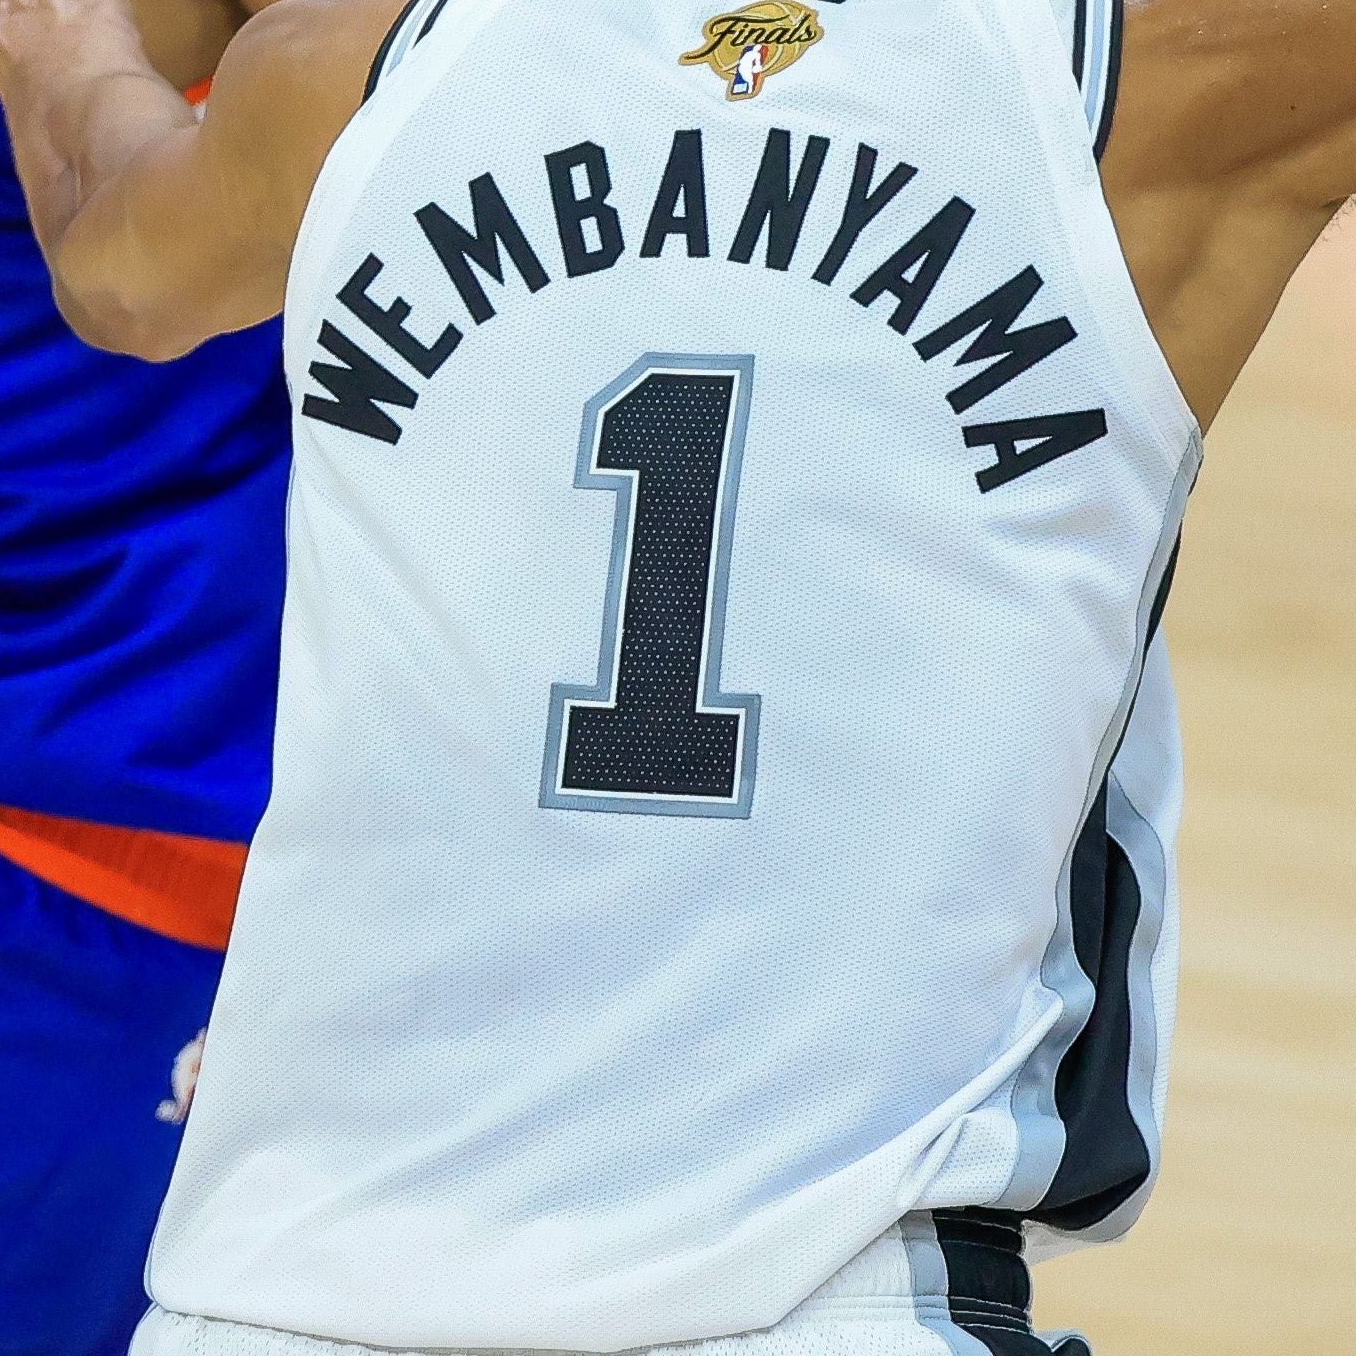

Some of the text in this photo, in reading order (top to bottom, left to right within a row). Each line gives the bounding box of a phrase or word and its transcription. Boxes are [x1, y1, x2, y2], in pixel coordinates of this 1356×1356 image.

[683, 11, 818, 61] Finals
[301, 128, 1108, 494] WEMBANYAMA
[538, 351, 761, 819] 1
